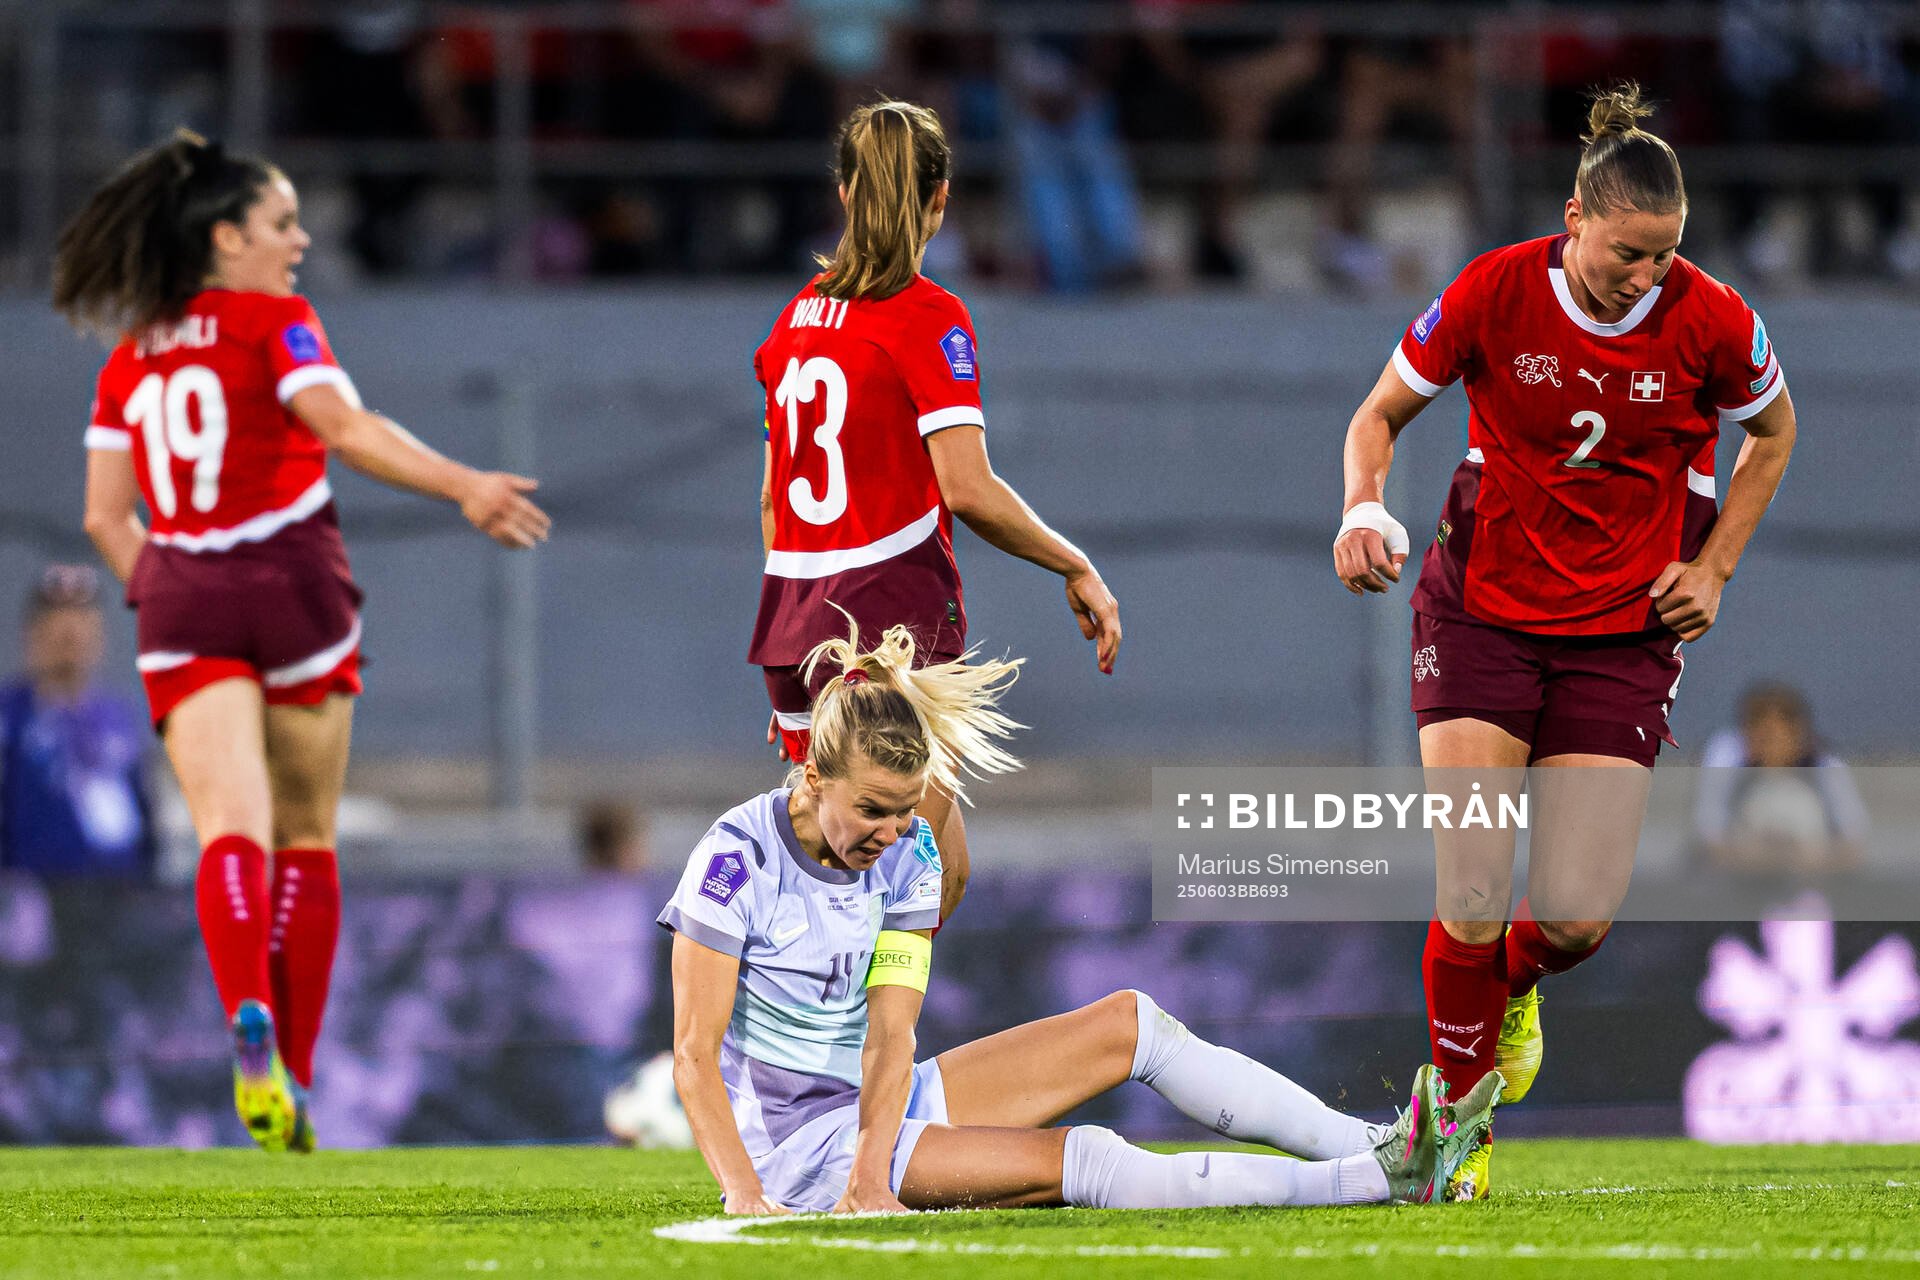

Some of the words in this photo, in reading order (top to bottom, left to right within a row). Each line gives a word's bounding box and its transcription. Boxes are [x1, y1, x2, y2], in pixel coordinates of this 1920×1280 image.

[123, 364, 229, 518] 19
[775, 356, 848, 525] 13
[1563, 411, 1606, 468] 2
[872, 953, 912, 965] ESPECT
[1433, 1019, 1484, 1033] SUISSE
